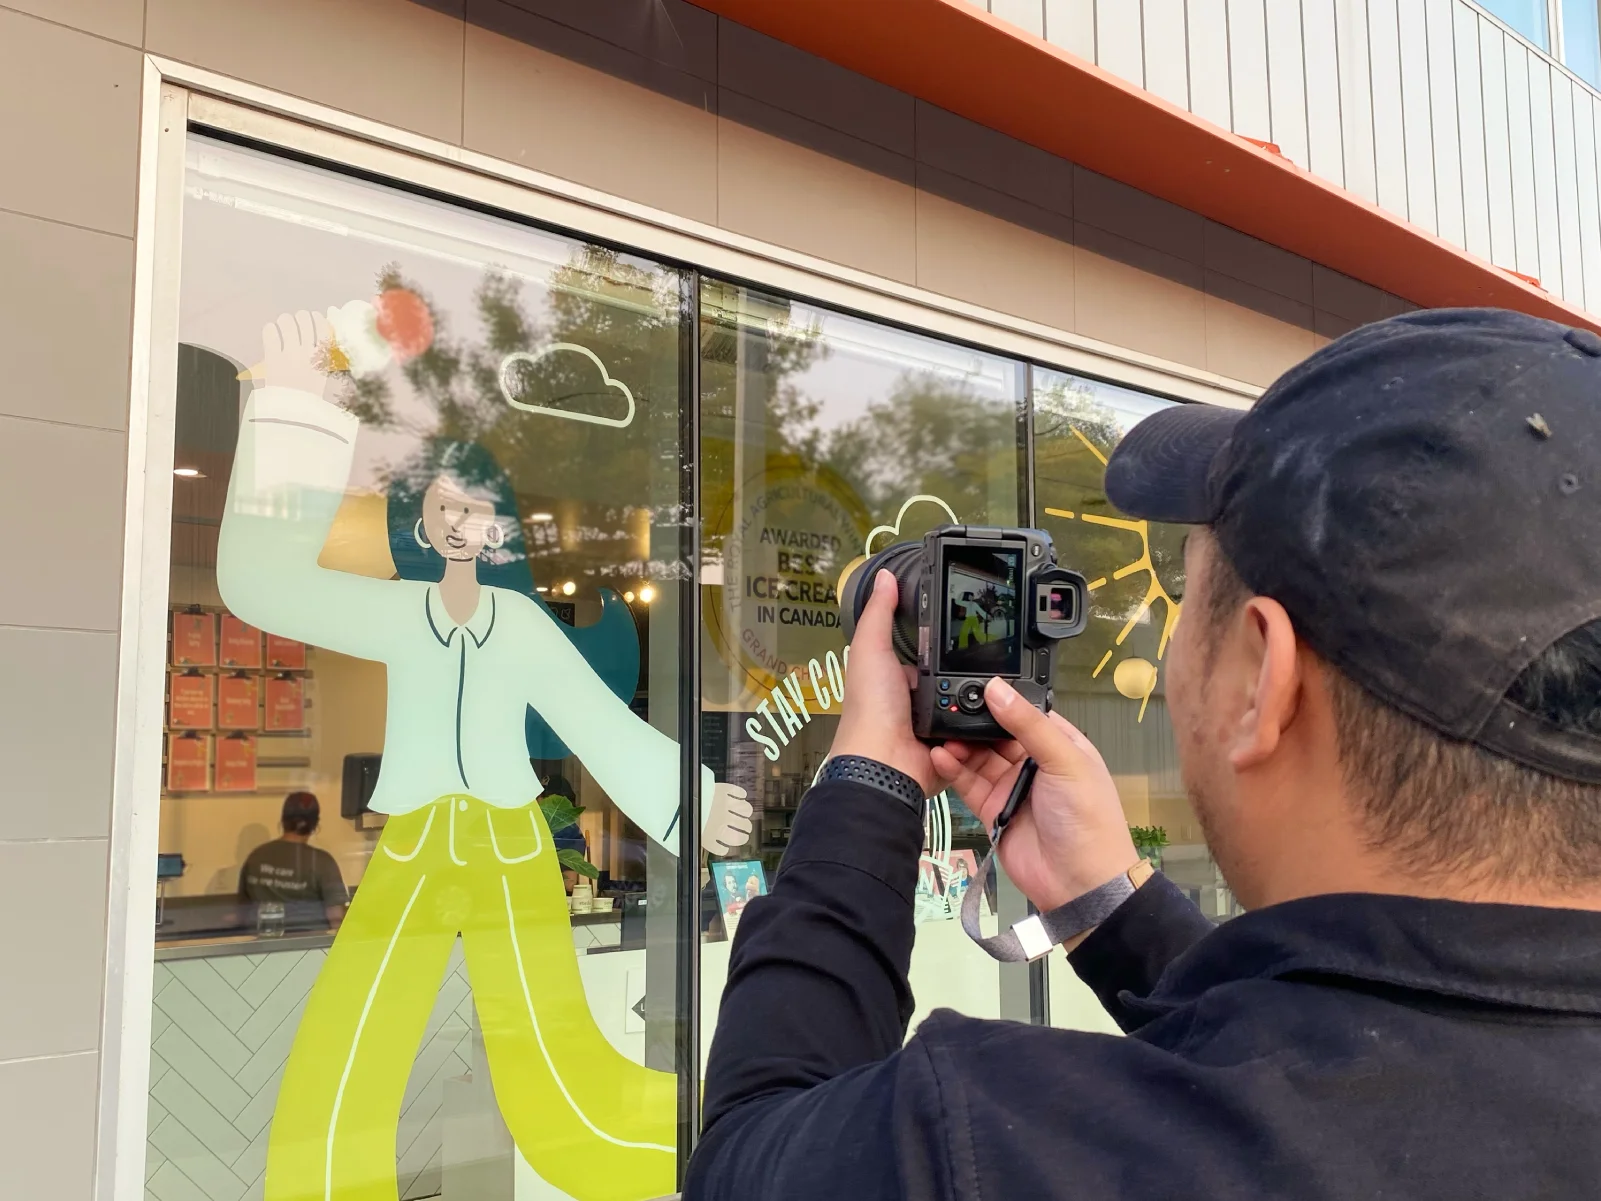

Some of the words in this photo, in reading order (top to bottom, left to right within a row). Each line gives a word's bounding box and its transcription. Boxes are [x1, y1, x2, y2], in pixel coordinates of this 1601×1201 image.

[760, 527, 842, 551] AWARDED
[727, 576, 741, 613] THE
[746, 575, 781, 600] ICE
[785, 579, 839, 604] CREA
[757, 605, 775, 623] IN
[742, 628, 787, 674] GRAND
[745, 671, 811, 761] STAY
